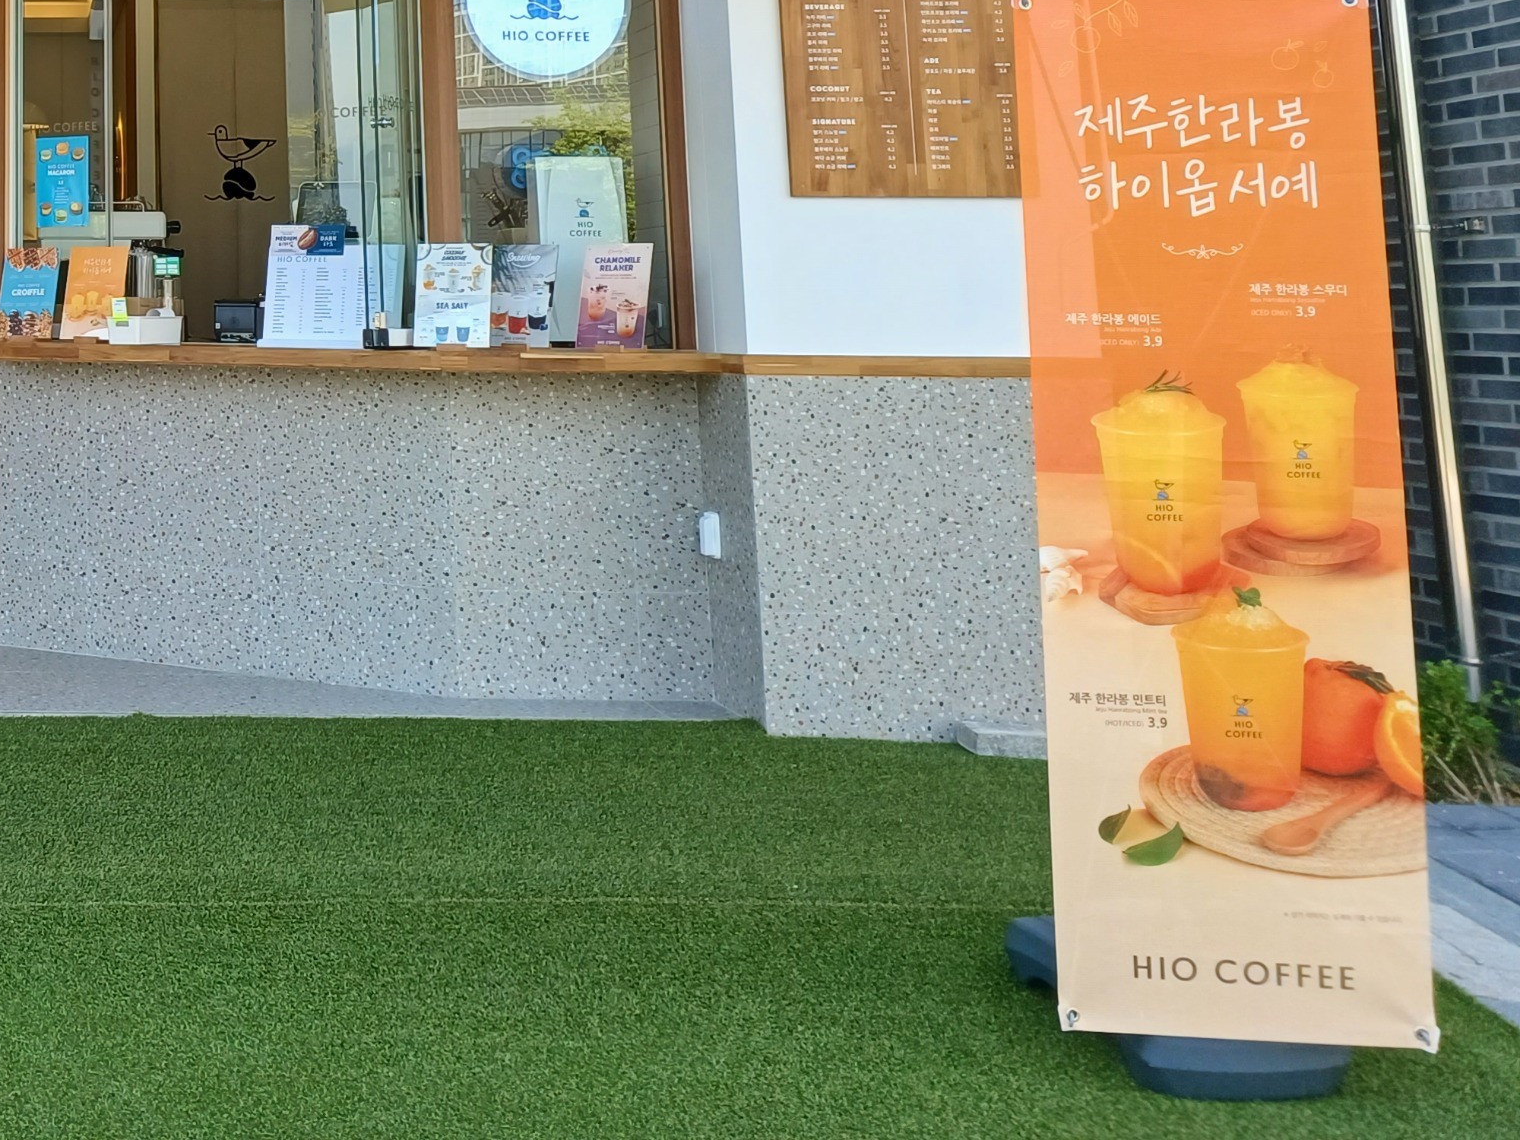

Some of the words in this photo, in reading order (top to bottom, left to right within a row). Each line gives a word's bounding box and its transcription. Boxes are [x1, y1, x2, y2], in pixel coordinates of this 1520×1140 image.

[502, 31, 528, 41] HIO
[535, 31, 590, 42] COFFEE
[810, 85, 850, 93] COCONUT
[569, 229, 602, 237] COFFEE
[594, 256, 642, 264] CHAMOMILE
[1249, 283, 1270, 296] 제주
[1276, 284, 1309, 296] 한라봉
[1312, 284, 1348, 296] 스무디
[1295, 306, 1316, 318] 3.9
[1065, 313, 1088, 324] 제주
[1091, 313, 1124, 325] 한라봉
[1127, 313, 1162, 325] 에이드
[1143, 335, 1163, 347] 3.9
[1286, 471, 1321, 479] COFFEE
[1155, 504, 1174, 512] HIO
[1146, 513, 1184, 522] COFFEE
[1069, 692, 1092, 704] 제주
[1095, 693, 1129, 705] 한라봉
[1132, 694, 1166, 706] 민트티
[1148, 717, 1168, 729] 3.9
[1234, 721, 1253, 729] HIO
[1225, 730, 1263, 739] COFFEE
[1133, 955, 1198, 982] HIO
[1215, 959, 1356, 991] COFFEE
